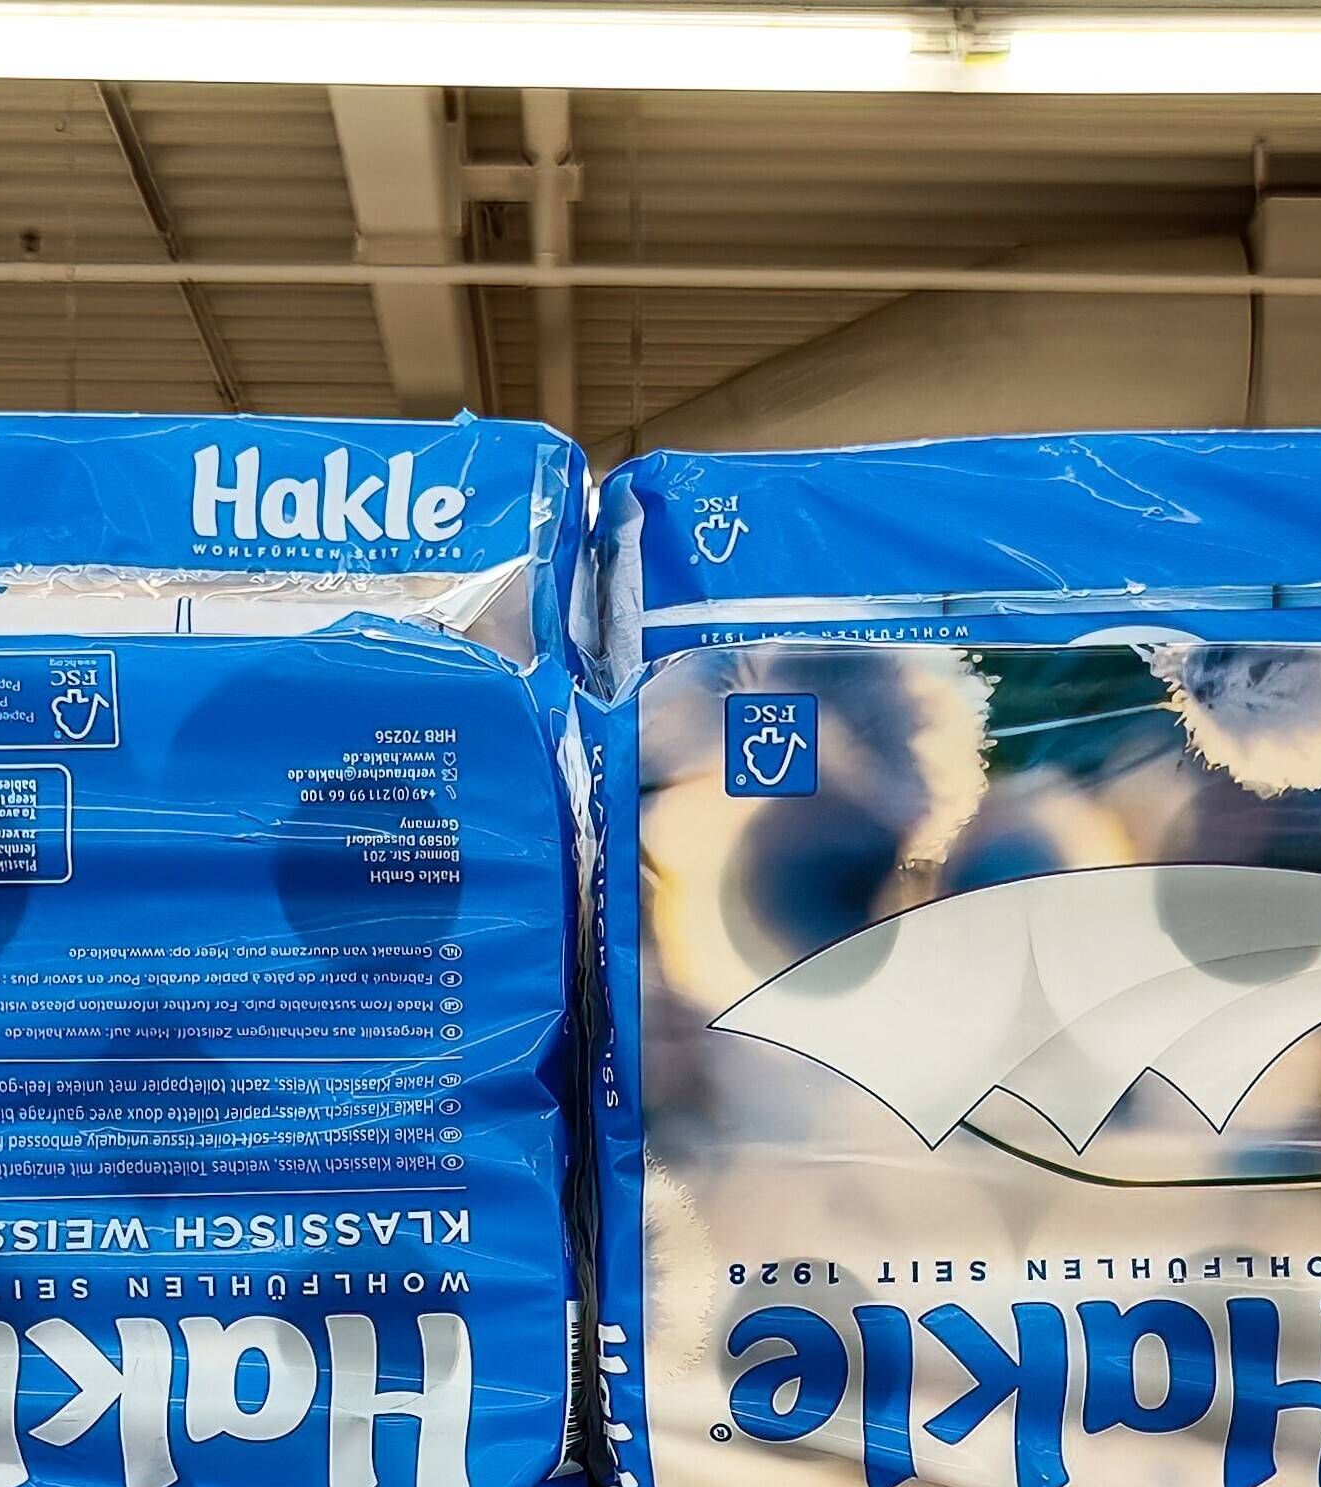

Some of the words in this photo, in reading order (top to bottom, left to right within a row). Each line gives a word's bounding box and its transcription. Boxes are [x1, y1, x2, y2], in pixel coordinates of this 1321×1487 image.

[695, 496, 737, 512] FSC
[192, 544, 341, 559] WOHLFÜHLEN
[356, 546, 399, 559] SEIT
[744, 705, 796, 723] FSC
[5, 1028, 101, 1039] www.hakle.de
[105, 1028, 131, 1039] auf:
[136, 1027, 170, 1039] Mehr
[174, 1027, 232, 1039] Zellstoff.
[237, 1025, 328, 1038] nachhaltigem
[333, 1027, 356, 1037] aus
[361, 1025, 433, 1038] Hergestellt
[56, 1080, 104, 1094] unieke
[109, 1080, 136, 1094] met
[142, 1076, 225, 1095] toiletpapier
[231, 1079, 271, 1094] zacht
[326, 1078, 391, 1094] Klassisch
[395, 1075, 434, 1090] Hakle
[90, 1108, 123, 1121] avec
[225, 1104, 271, 1120] papier
[326, 1102, 390, 1118] Klassisch
[395, 1100, 433, 1114] Hakle
[19, 1106, 84, 1124] gaufrage
[128, 1108, 163, 1124] doux
[167, 1108, 219, 1123] toilette
[87, 1133, 148, 1149] uniquely
[153, 1134, 195, 1148] tissue
[200, 1133, 236, 1148] toilet
[242, 1132, 269, 1147] soft
[324, 1129, 390, 1145] Klassisch
[395, 1128, 434, 1142] Hakle
[9, 1136, 82, 1150] embossed
[70, 1163, 93, 1177] mit
[99, 1159, 207, 1178] Toilettenpapier
[212, 1160, 269, 1176] weiches
[325, 1157, 391, 1174] Klassisch
[396, 1156, 436, 1171] Hakle
[174, 1209, 469, 1251] KLASSISCH
[727, 1261, 838, 1285] 1928
[878, 1259, 987, 1284] SEIT
[128, 1271, 469, 1299] WOHLFÜHLEN
